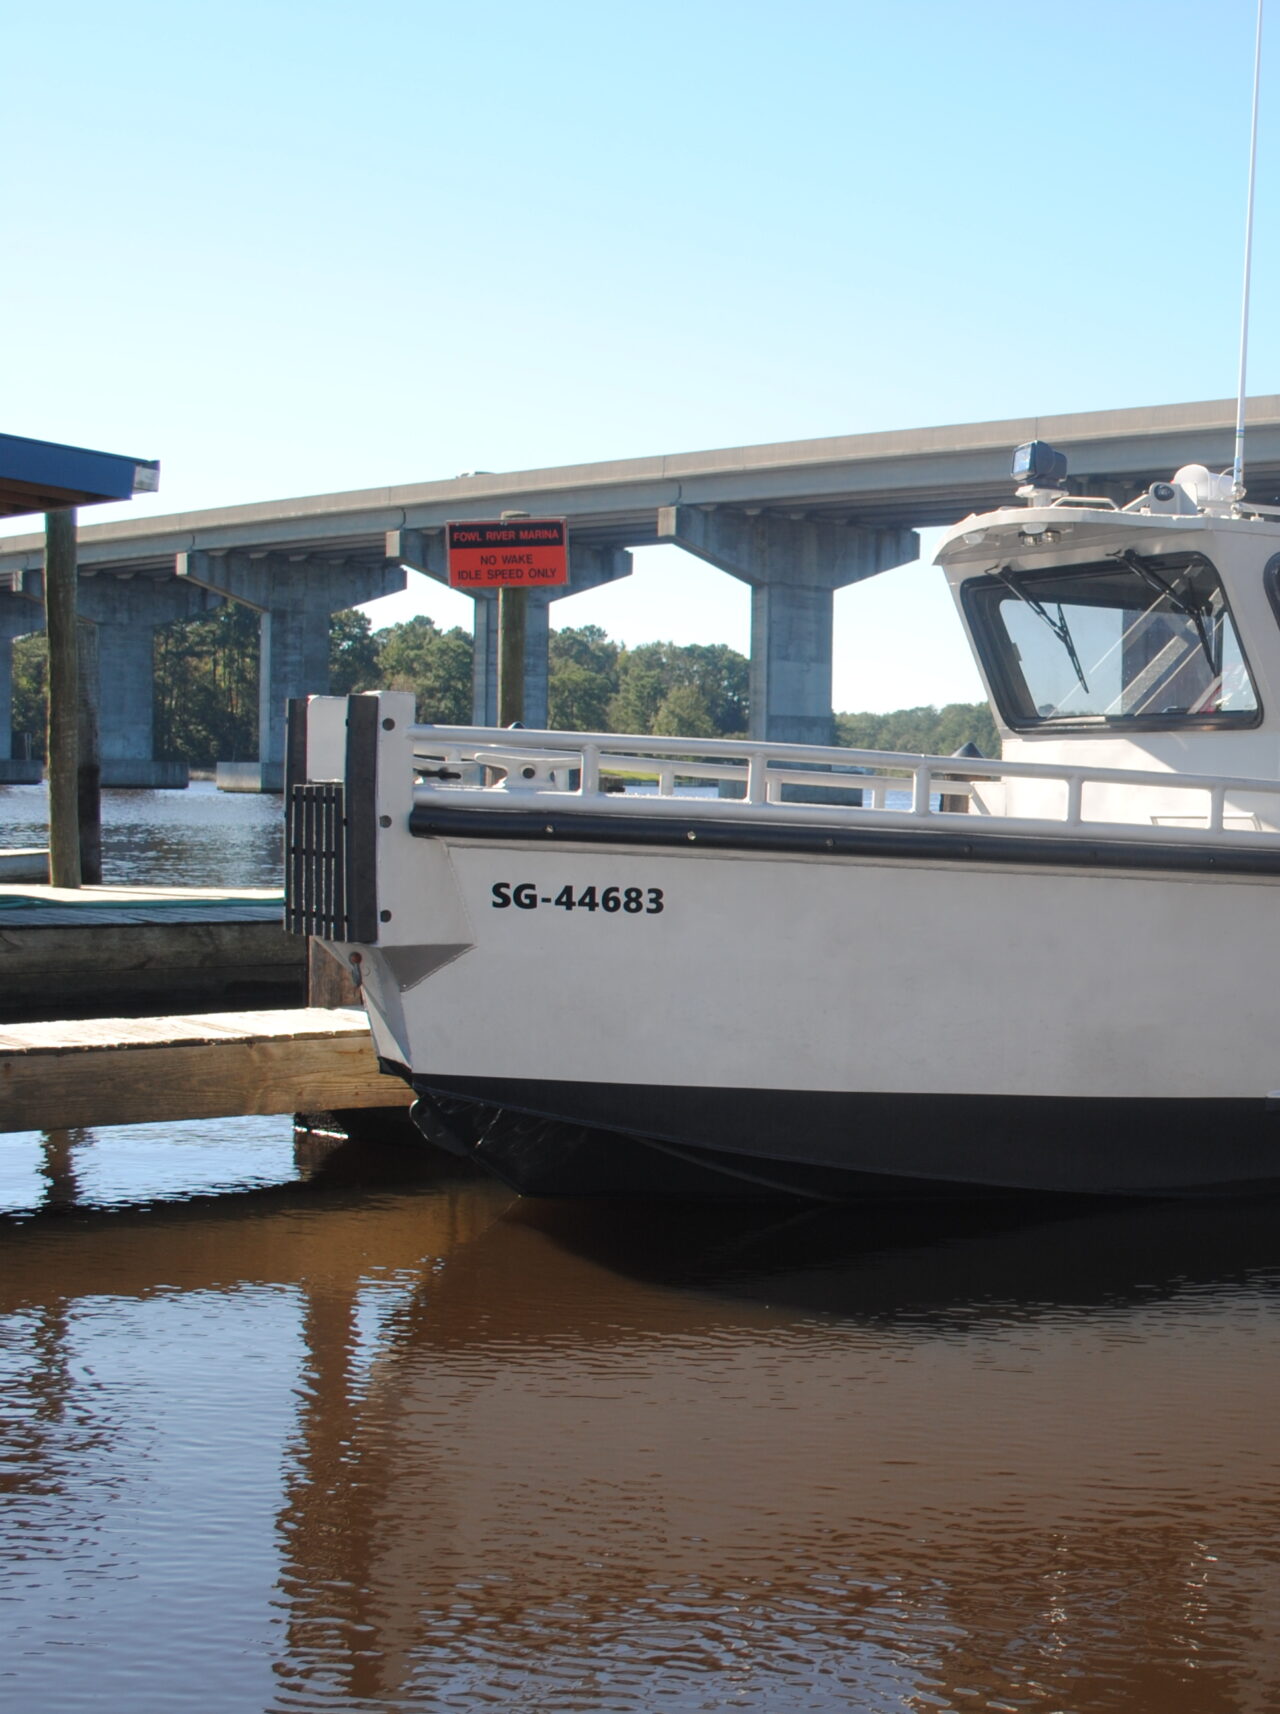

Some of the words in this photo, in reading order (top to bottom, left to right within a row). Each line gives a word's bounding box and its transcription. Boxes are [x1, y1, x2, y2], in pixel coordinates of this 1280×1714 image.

[453, 531, 482, 541] FOWL
[486, 530, 515, 541] RIVER
[520, 529, 559, 539] MARINA
[480, 555, 496, 565] NO
[501, 554, 533, 564] WAKE
[458, 570, 481, 580] IDLE
[487, 568, 524, 580] SPEED
[528, 568, 557, 578] ONLY
[491, 882, 664, 914] SG-44683
